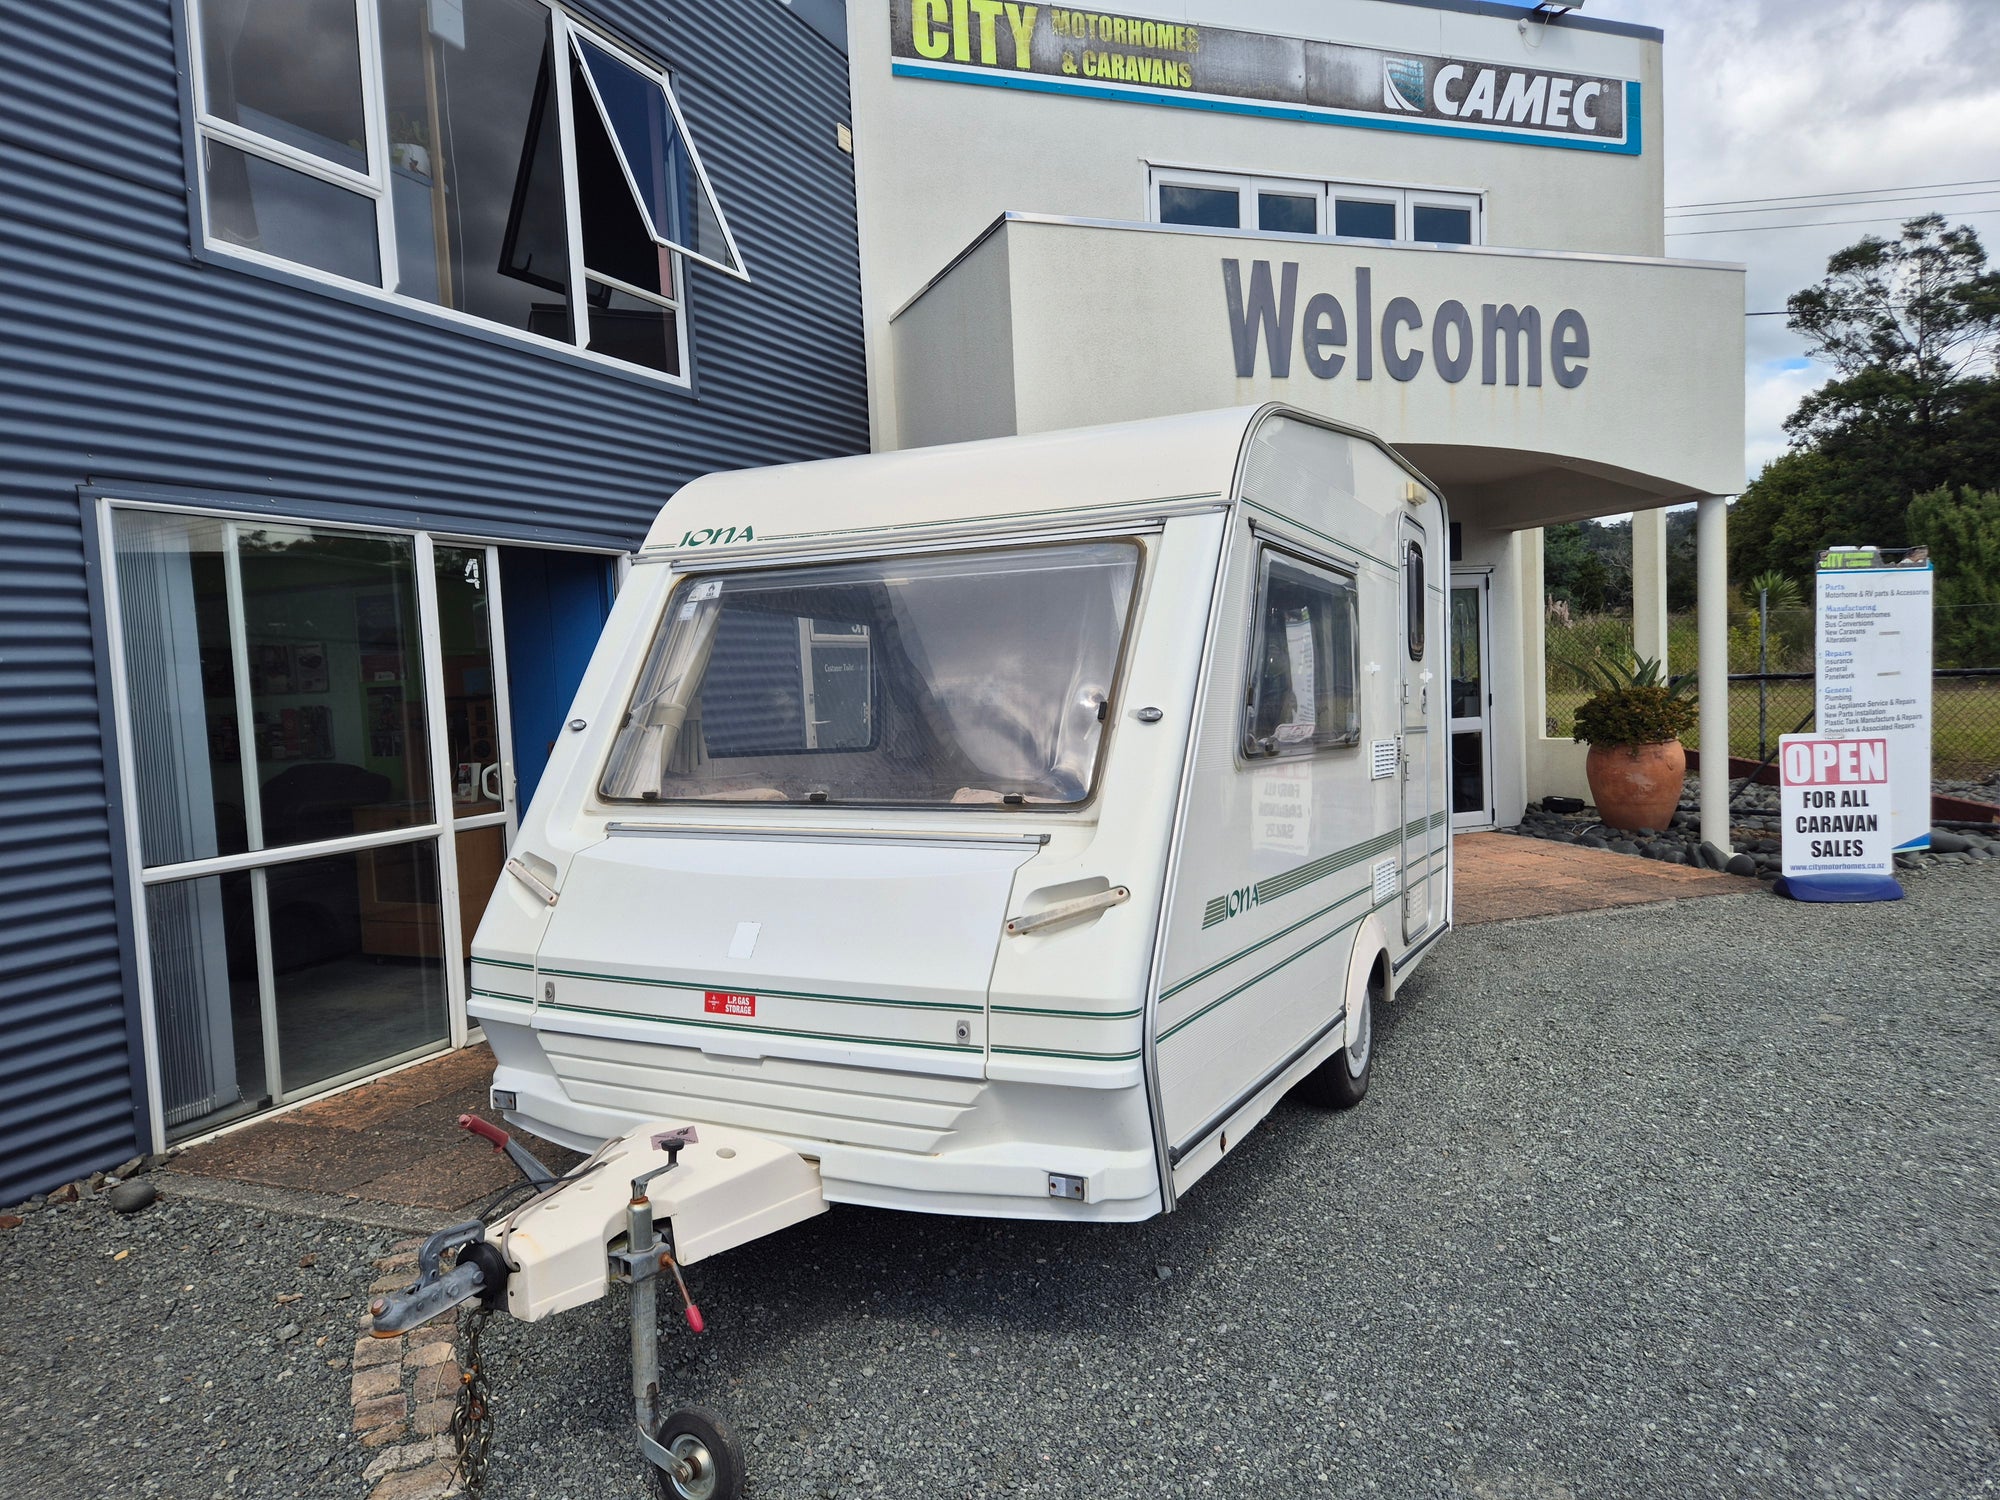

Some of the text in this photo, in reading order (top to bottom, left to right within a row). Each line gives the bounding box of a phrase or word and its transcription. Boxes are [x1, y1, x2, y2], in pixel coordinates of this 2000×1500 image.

[912, 0, 1038, 69] CITY
[1052, 10, 1199, 53] MOTORHOMES
[1062, 50, 1193, 88] & CARAVANS
[1433, 64, 1601, 130] CAMEC
[1221, 258, 1590, 389] Welcome
[1825, 583, 1845, 591] Parts
[1825, 591, 1858, 599] Motorhome
[1874, 590, 1889, 598] parts
[1826, 604, 1877, 612] Manufacturing
[1839, 612, 1854, 620] Build
[1855, 611, 1891, 619] Motorhomes
[1837, 702, 1866, 710] Appliance
[1895, 698, 1916, 706] Repairs
[1825, 719, 1844, 727] Plastic
[1785, 742, 1885, 784] OPEN
[1803, 789, 1869, 809] FOR ALL
[1796, 814, 1877, 833] CARAVAN
[1811, 839, 1863, 858] SALES
[1790, 863, 1885, 871] www.citymotorhomes.co.nz
[725, 1004, 752, 1015] STORAGE
